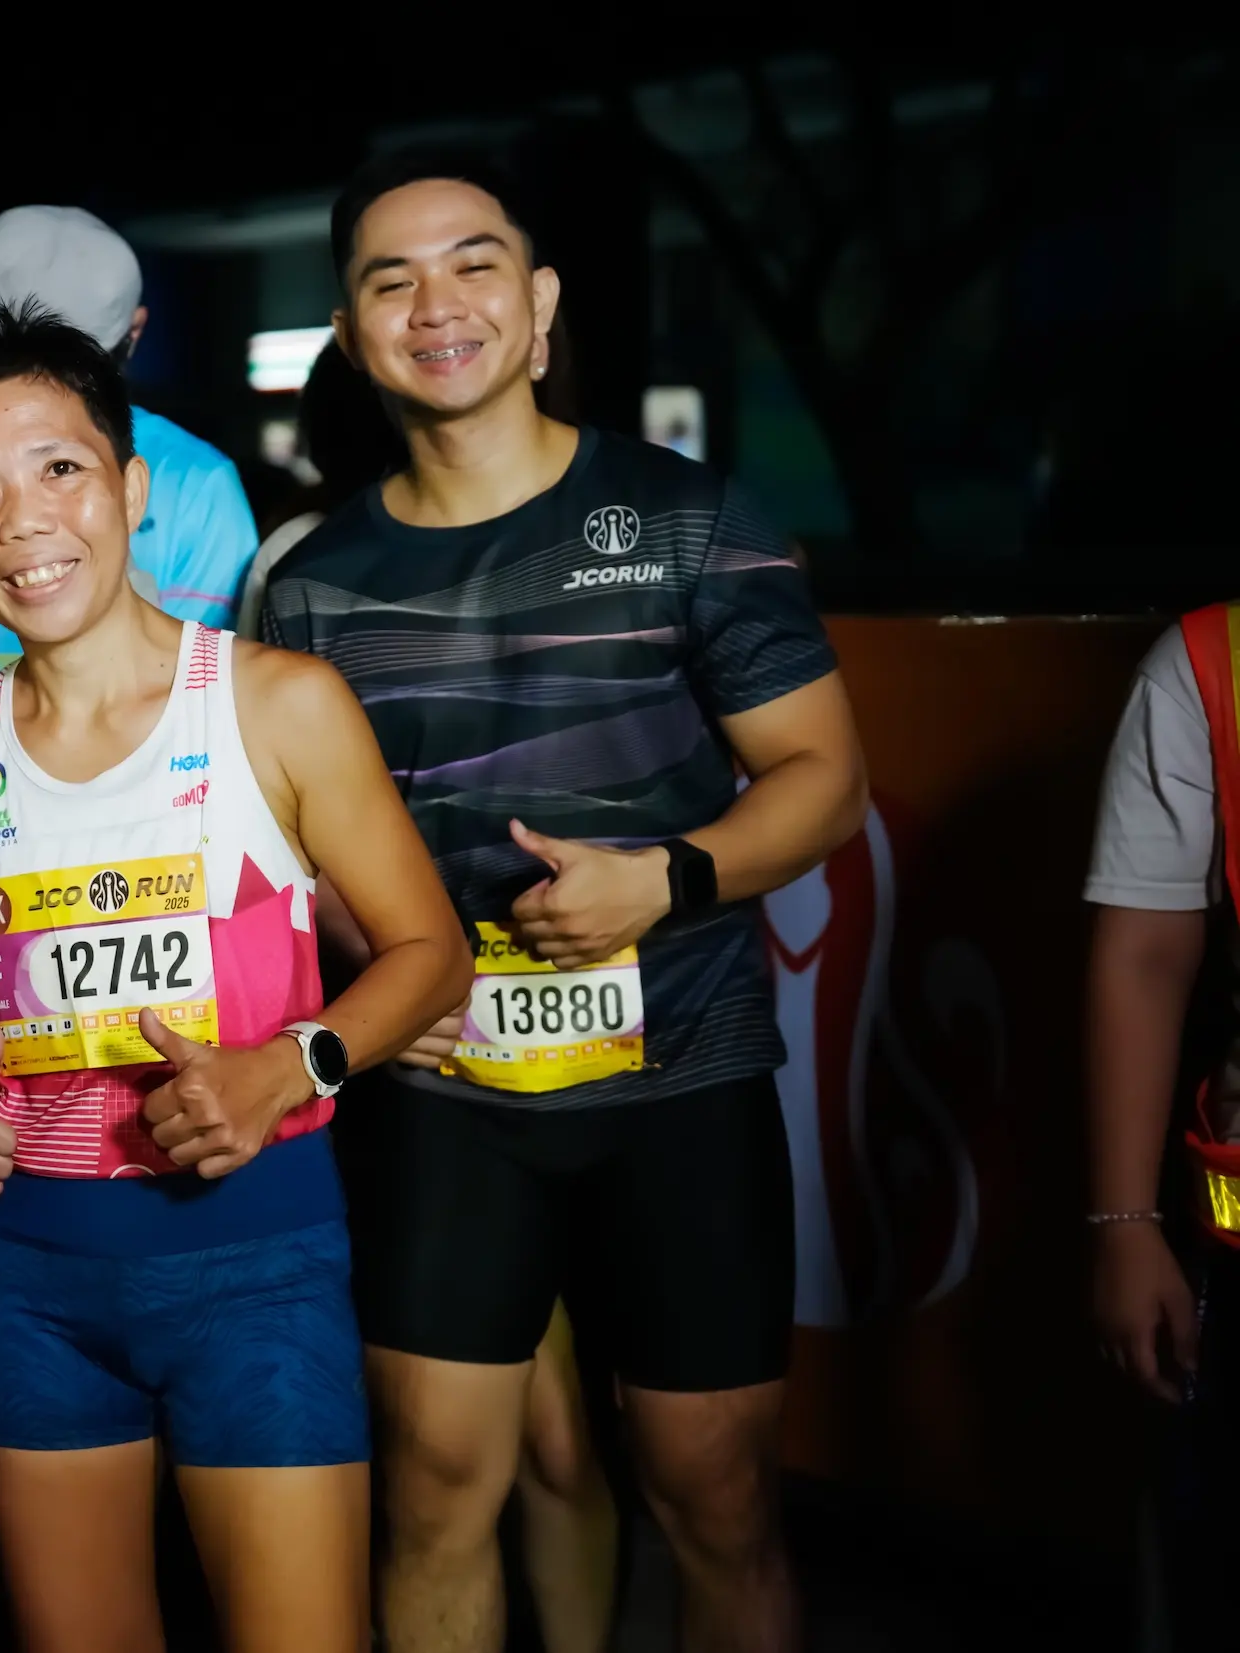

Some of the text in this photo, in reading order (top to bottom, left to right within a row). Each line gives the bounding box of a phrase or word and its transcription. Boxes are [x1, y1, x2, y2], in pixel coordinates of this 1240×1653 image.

[563, 564, 664, 590] JCORUN
[170, 752, 210, 771] HOKA
[173, 783, 207, 807] GOMO
[28, 873, 194, 911] JCO RUN
[164, 897, 190, 911] 2025
[51, 931, 192, 999] 12742
[490, 982, 624, 1034] 13880
